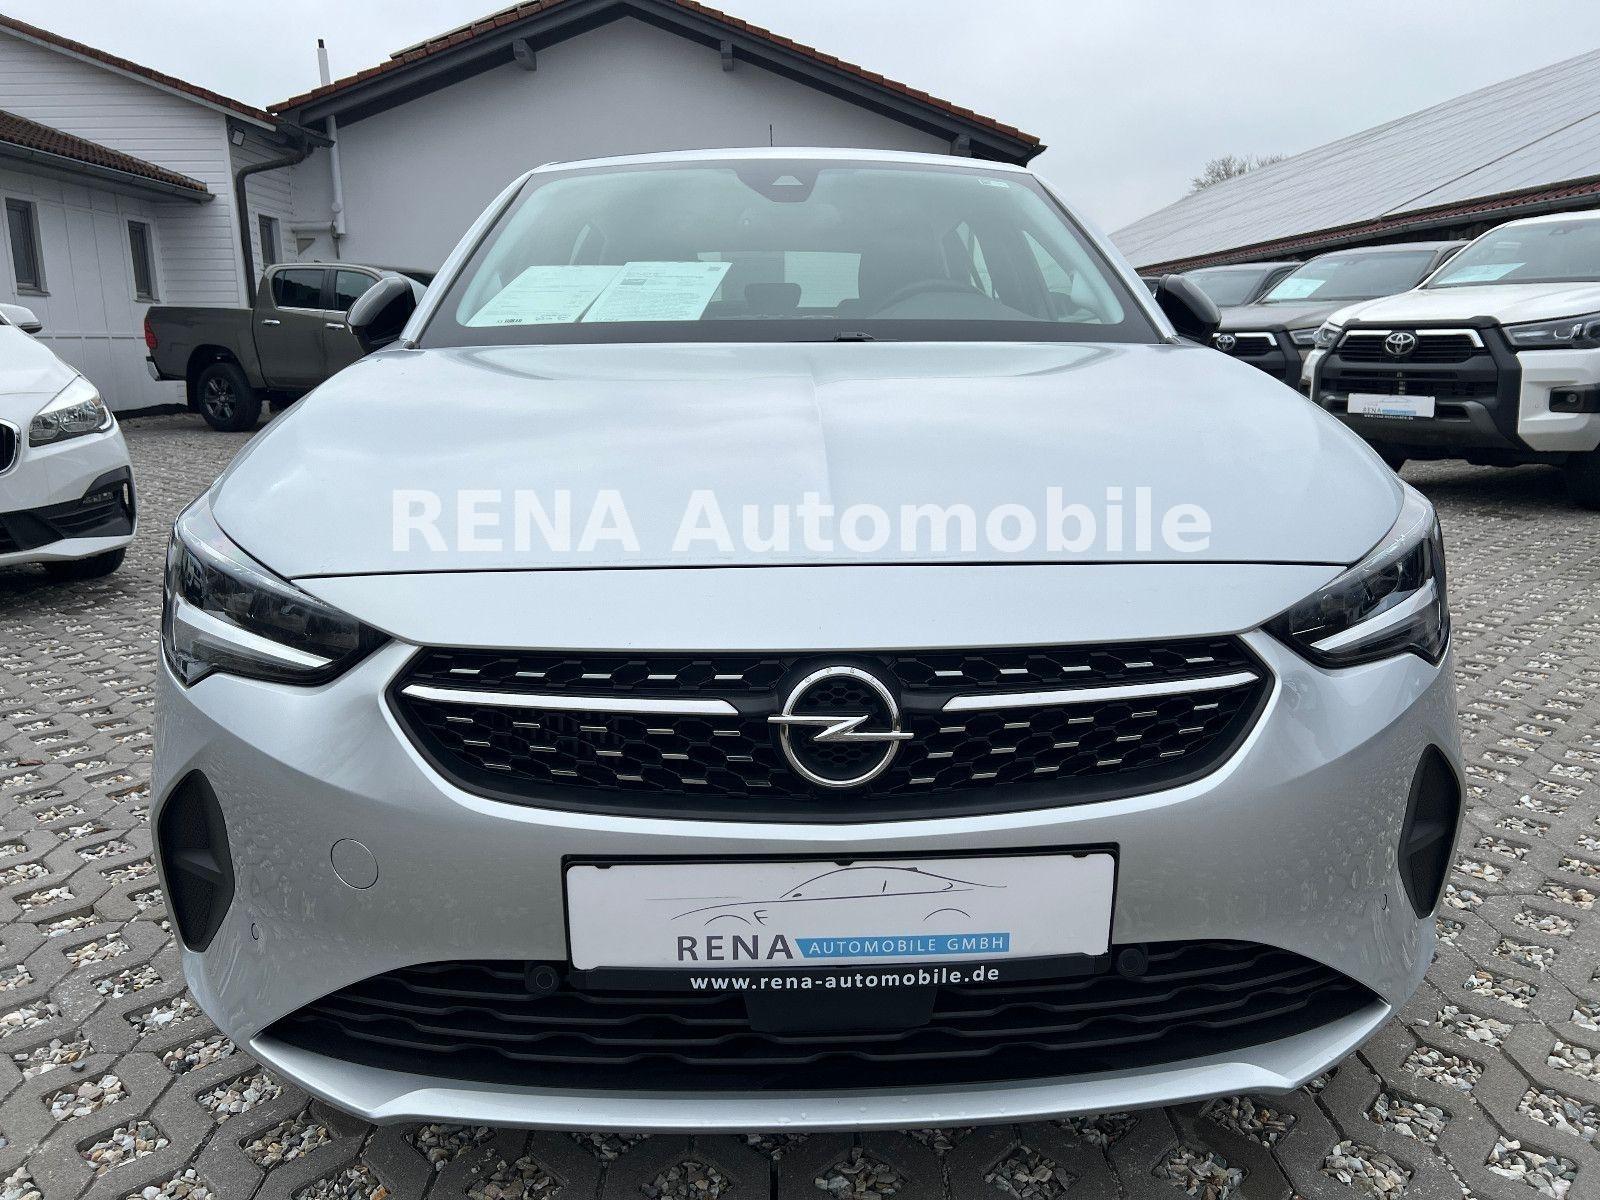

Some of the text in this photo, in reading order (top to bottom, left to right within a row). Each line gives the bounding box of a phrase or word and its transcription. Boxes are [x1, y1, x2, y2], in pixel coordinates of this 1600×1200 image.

[677, 934, 1005, 961] RENA AUTOMOBILE GMBH
[690, 965, 1000, 990] www.rena-automobile.de
